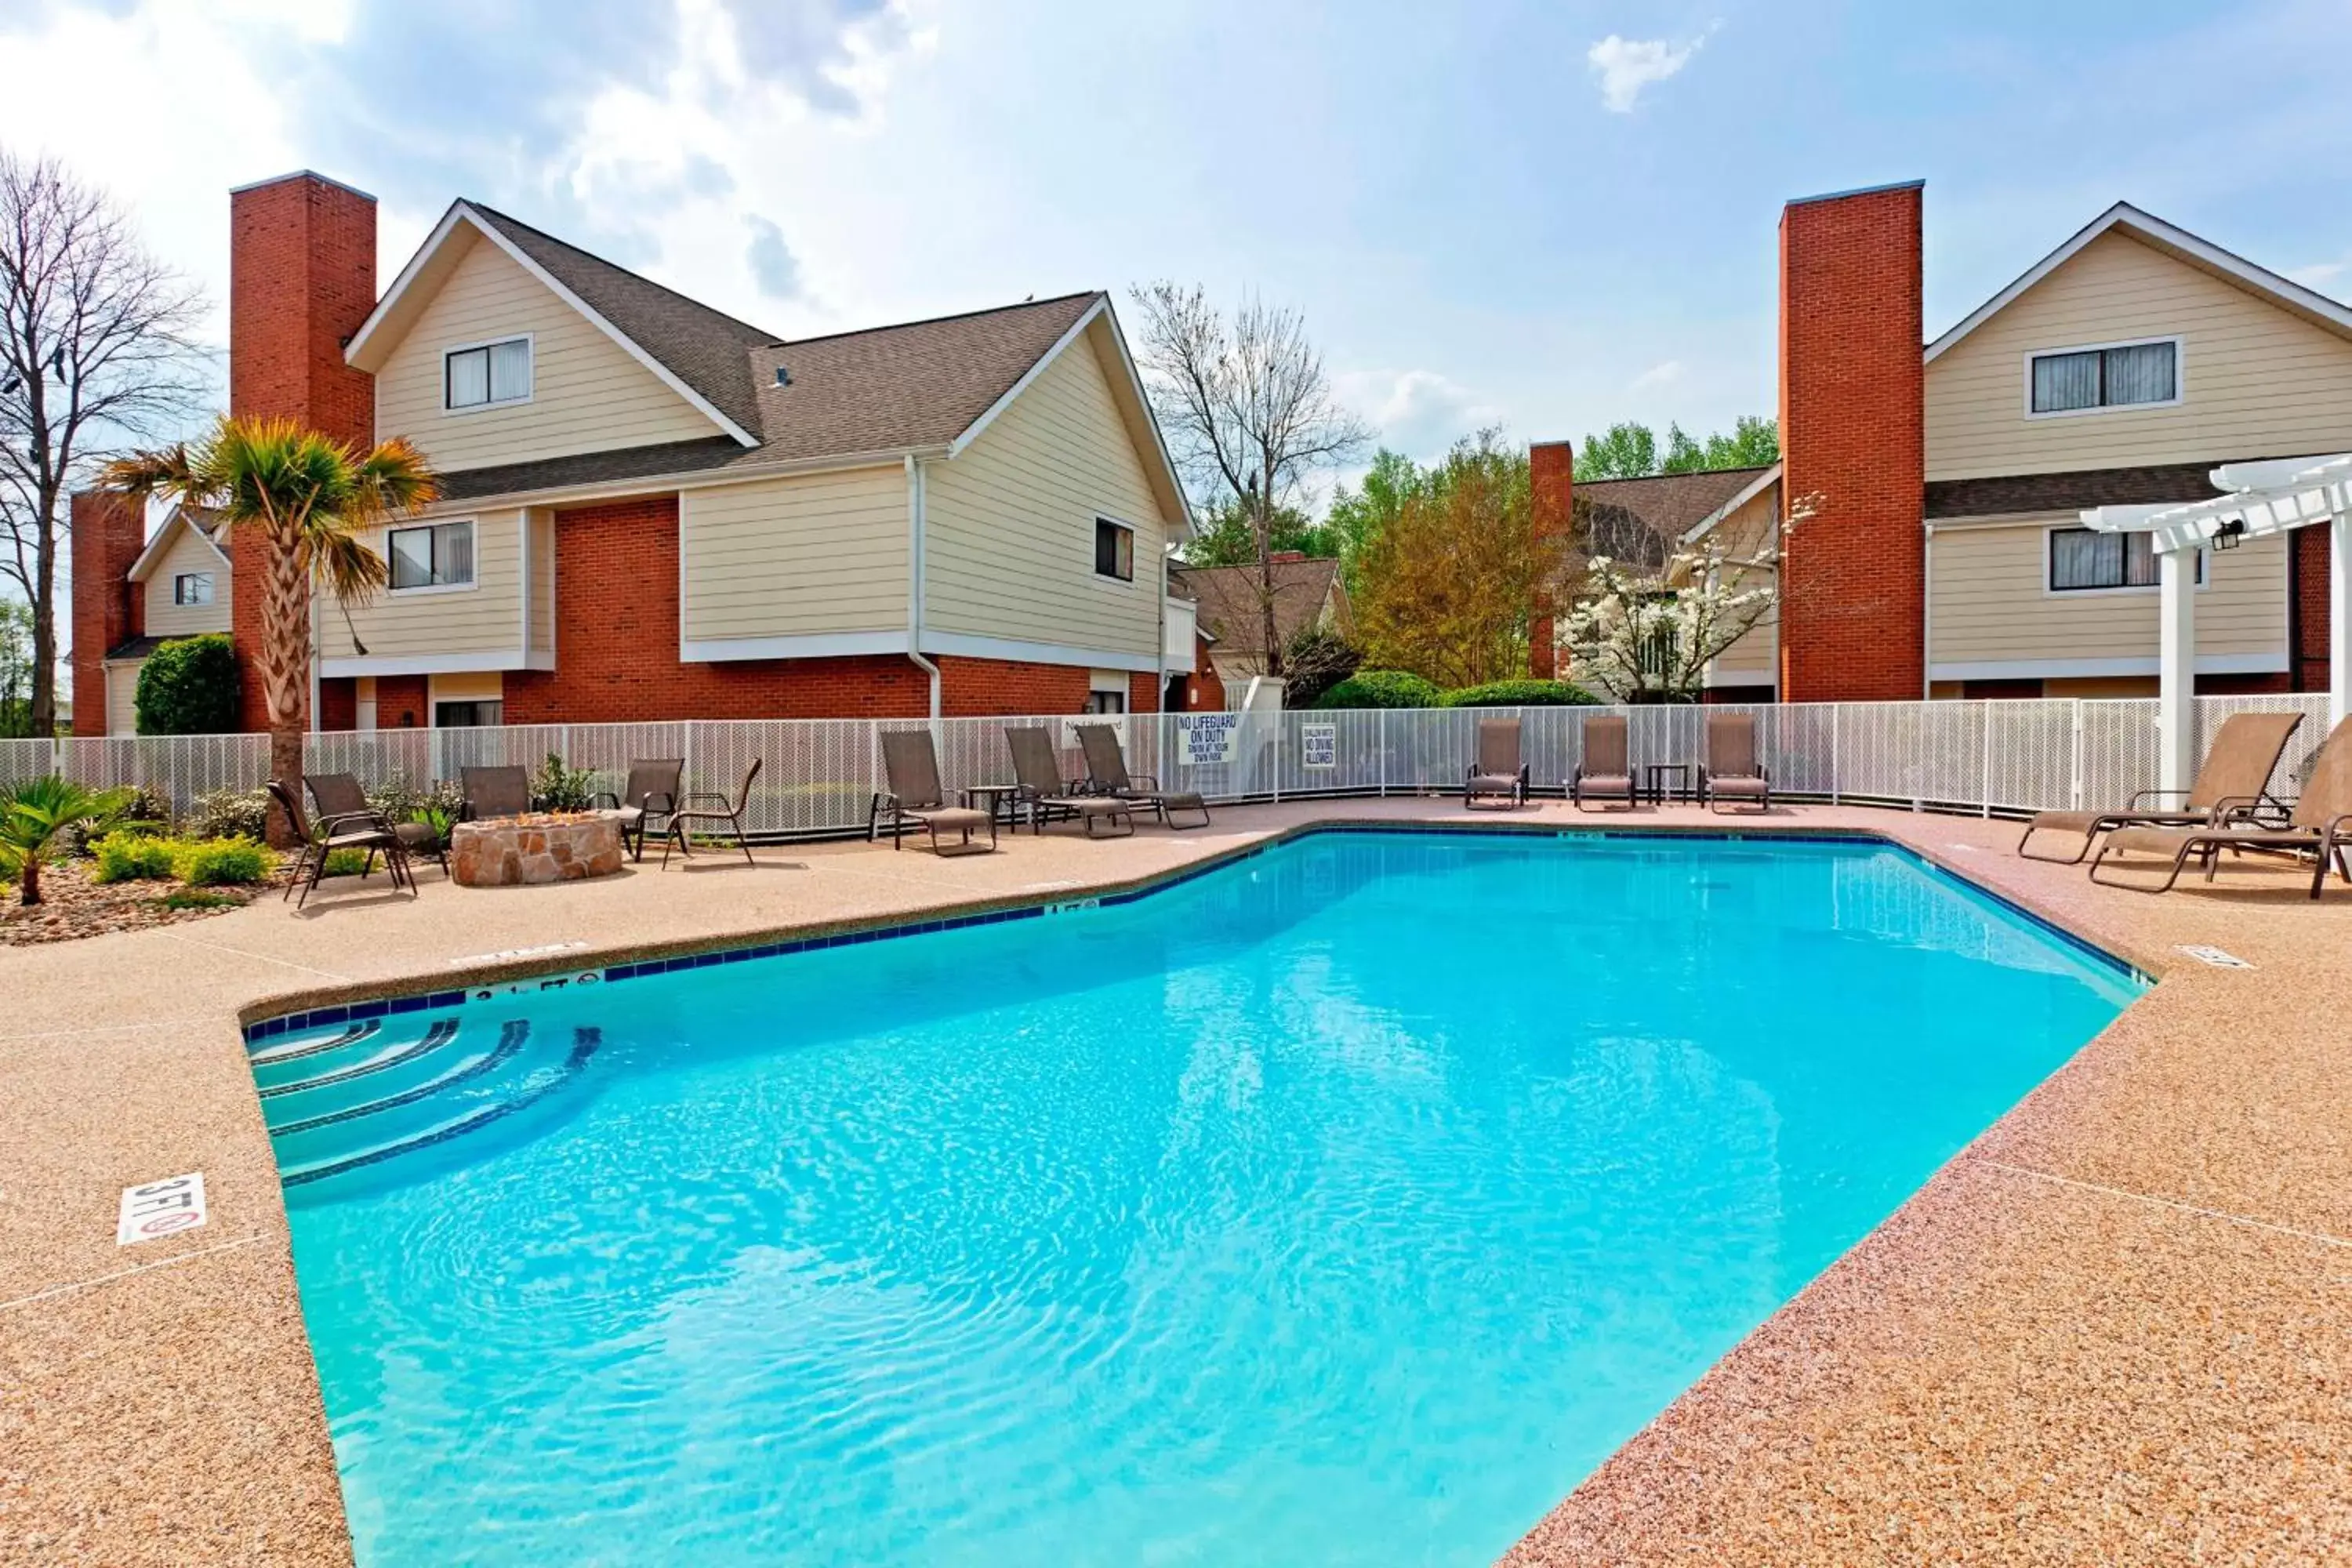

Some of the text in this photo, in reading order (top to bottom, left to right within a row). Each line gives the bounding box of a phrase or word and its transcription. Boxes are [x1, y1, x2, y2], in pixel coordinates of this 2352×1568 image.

[1179, 714, 1236, 729] NO LIFEGUARD
[1191, 729, 1225, 743] ON DUTY
[1305, 752, 1334, 764] ALLOWED
[132, 1179, 192, 1218] 3 FT
